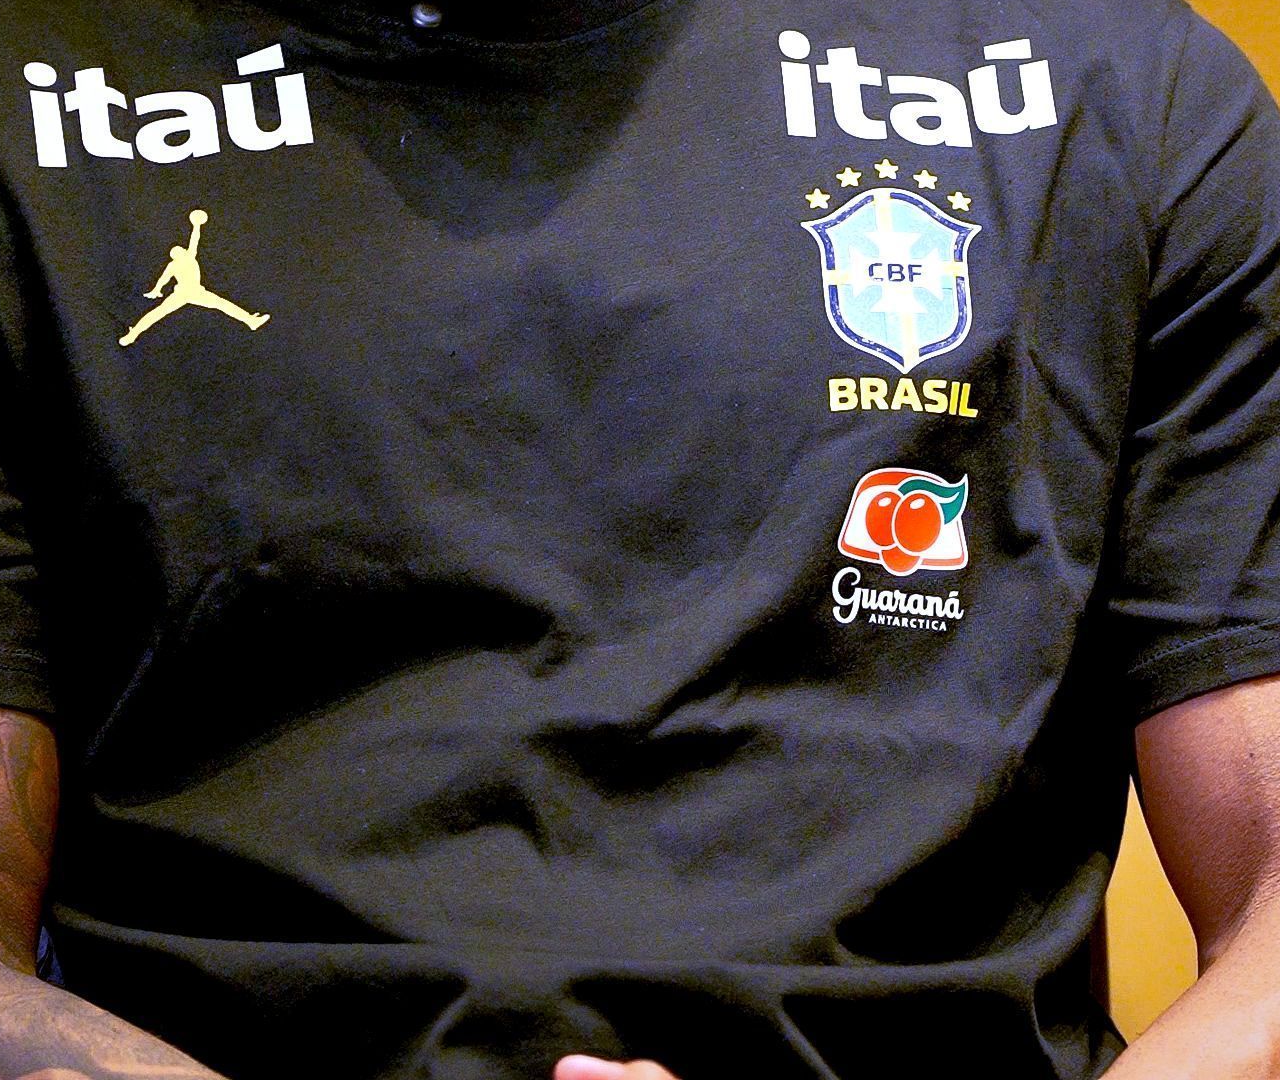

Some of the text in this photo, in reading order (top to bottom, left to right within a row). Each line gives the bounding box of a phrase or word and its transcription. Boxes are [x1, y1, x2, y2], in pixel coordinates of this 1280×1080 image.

[23, 43, 314, 168] itaú
[778, 29, 1058, 148] itaú
[868, 262, 923, 283] CBF
[828, 376, 978, 418] BRASIL
[832, 566, 964, 624] Guaraná
[868, 613, 947, 632] ANTARCTICA
